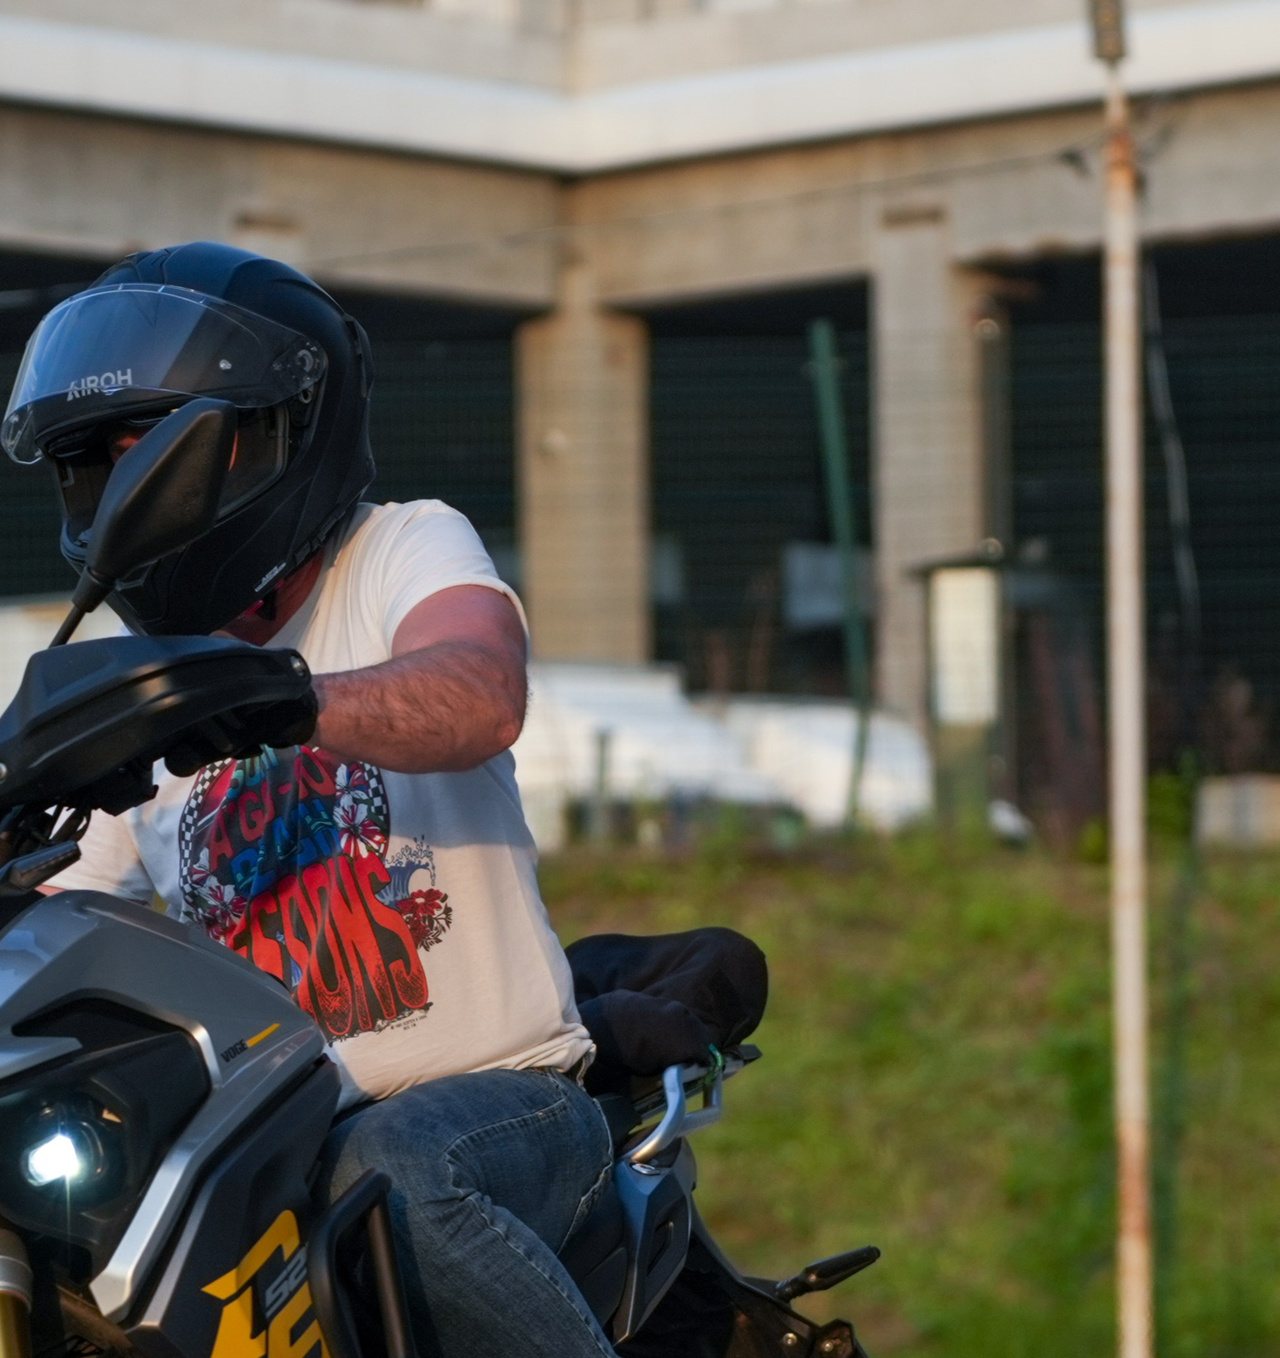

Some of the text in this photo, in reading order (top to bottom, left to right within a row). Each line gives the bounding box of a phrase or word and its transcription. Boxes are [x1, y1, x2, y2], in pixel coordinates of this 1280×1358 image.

[66, 367, 133, 402] AIROH
[220, 1038, 249, 1063] VOGE
[264, 1246, 308, 1320] 52
